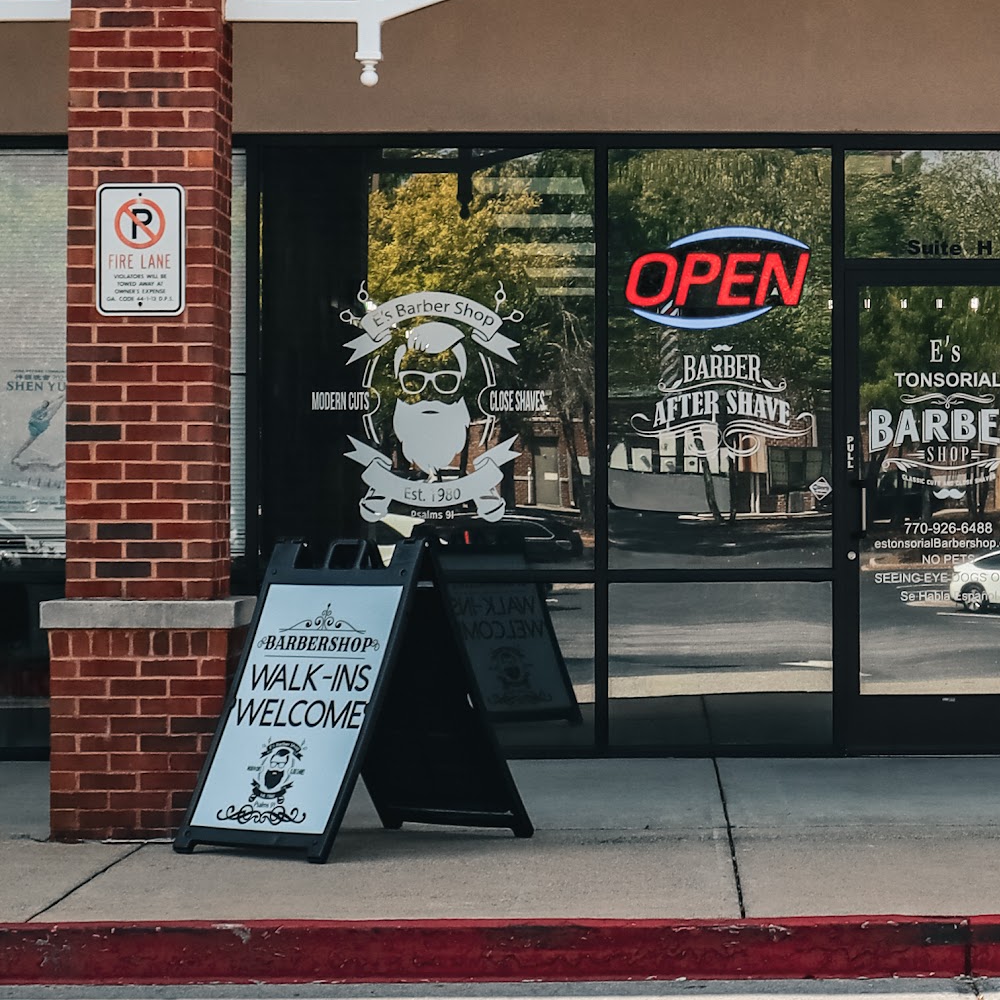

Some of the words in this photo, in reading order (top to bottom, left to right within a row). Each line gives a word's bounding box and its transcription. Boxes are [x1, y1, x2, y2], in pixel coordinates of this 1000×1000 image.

[907, 239, 962, 256] Suite
[977, 240, 992, 256] H
[108, 253, 134, 270] FIRE
[140, 253, 172, 270] LANE
[625, 252, 811, 307] OPEN
[372, 310, 393, 328] E's
[395, 299, 451, 317] Barber
[454, 301, 495, 327] Shop
[929, 334, 961, 363] E's
[683, 354, 762, 384] BARBER
[6, 381, 44, 392] SHEN
[311, 391, 347, 411] MODERN
[348, 391, 370, 411] CUTS
[489, 389, 515, 411] CLOSE
[515, 389, 546, 411] SHAVES
[652, 389, 720, 428] AFTER
[725, 389, 791, 426] SHAVE
[846, 435, 855, 469] PULL
[926, 445, 971, 463] SHOP
[901, 473, 926, 485] CLASSIC
[404, 486, 426, 501] Est.
[904, 521, 993, 535] 770-926-6488
[922, 554, 941, 565] NO
[943, 553, 975, 565] PETS
[874, 572, 921, 584] SEEING
[924, 572, 948, 583] EYE
[953, 572, 987, 583] DOGS
[900, 590, 915, 602] Se
[918, 590, 950, 602] Habla
[264, 635, 374, 653] BARBERSHOP
[251, 663, 372, 692] WALK-INS
[236, 698, 367, 729] WELCOME
